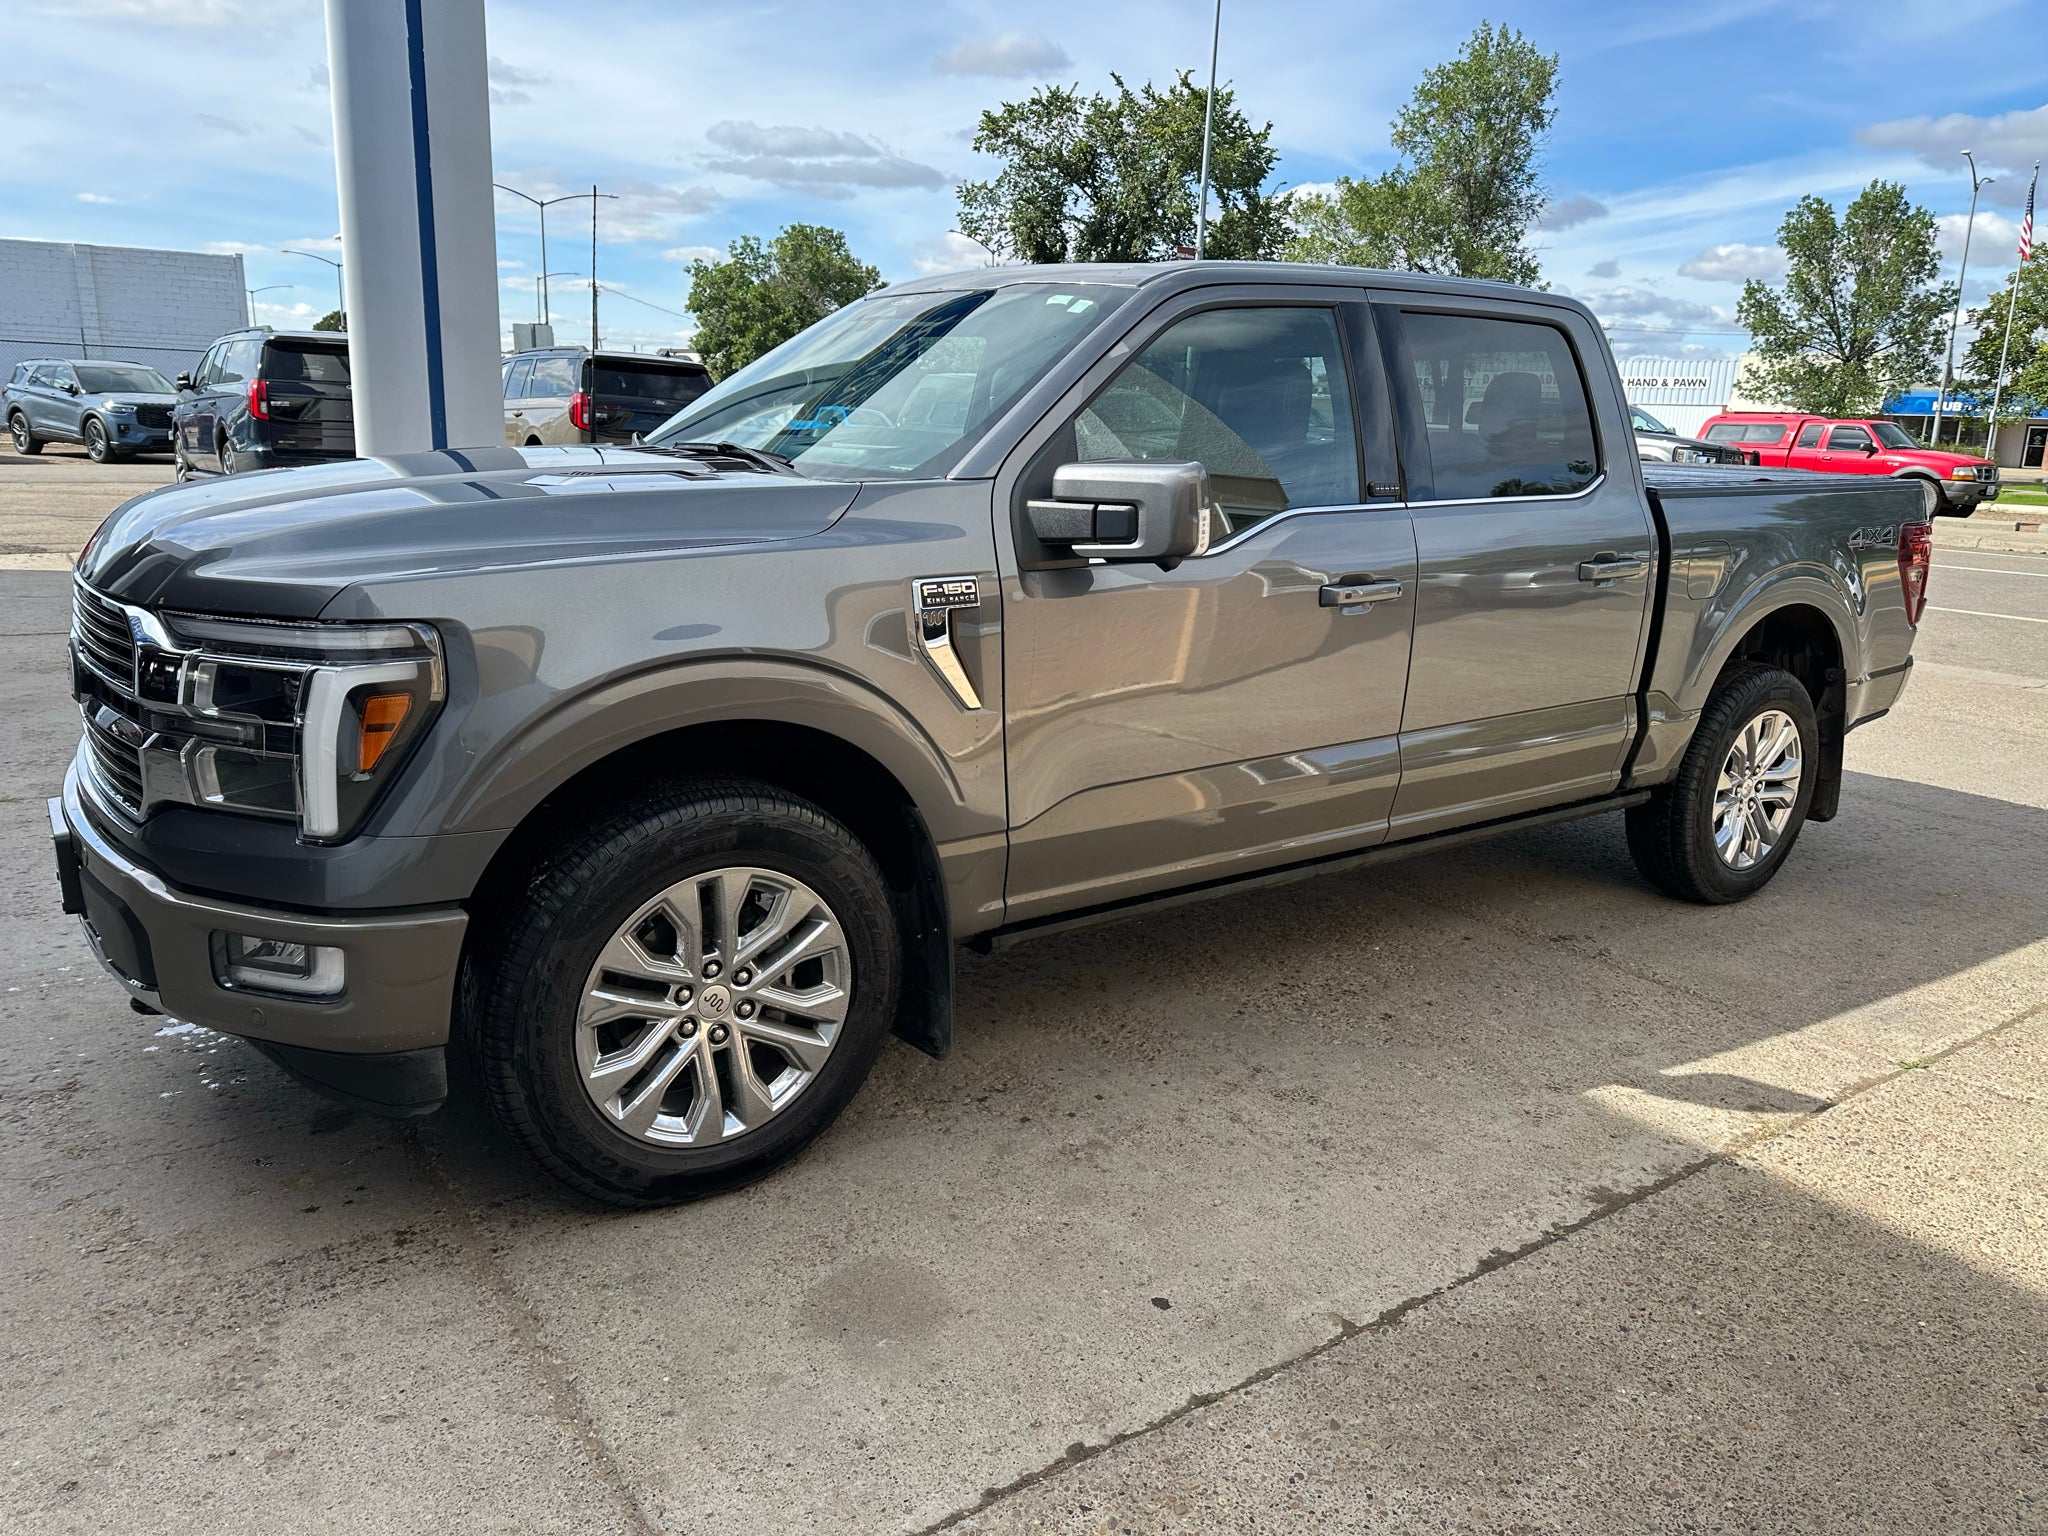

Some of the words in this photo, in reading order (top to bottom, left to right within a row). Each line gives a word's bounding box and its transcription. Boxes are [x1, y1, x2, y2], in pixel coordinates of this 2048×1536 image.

[1627, 378, 1658, 387] HAND
[1661, 378, 1669, 387] &
[1673, 378, 1708, 387] PAWN
[1932, 401, 1963, 412] HUB
[922, 582, 976, 596] F-150
[949, 594, 975, 602] RANCH
